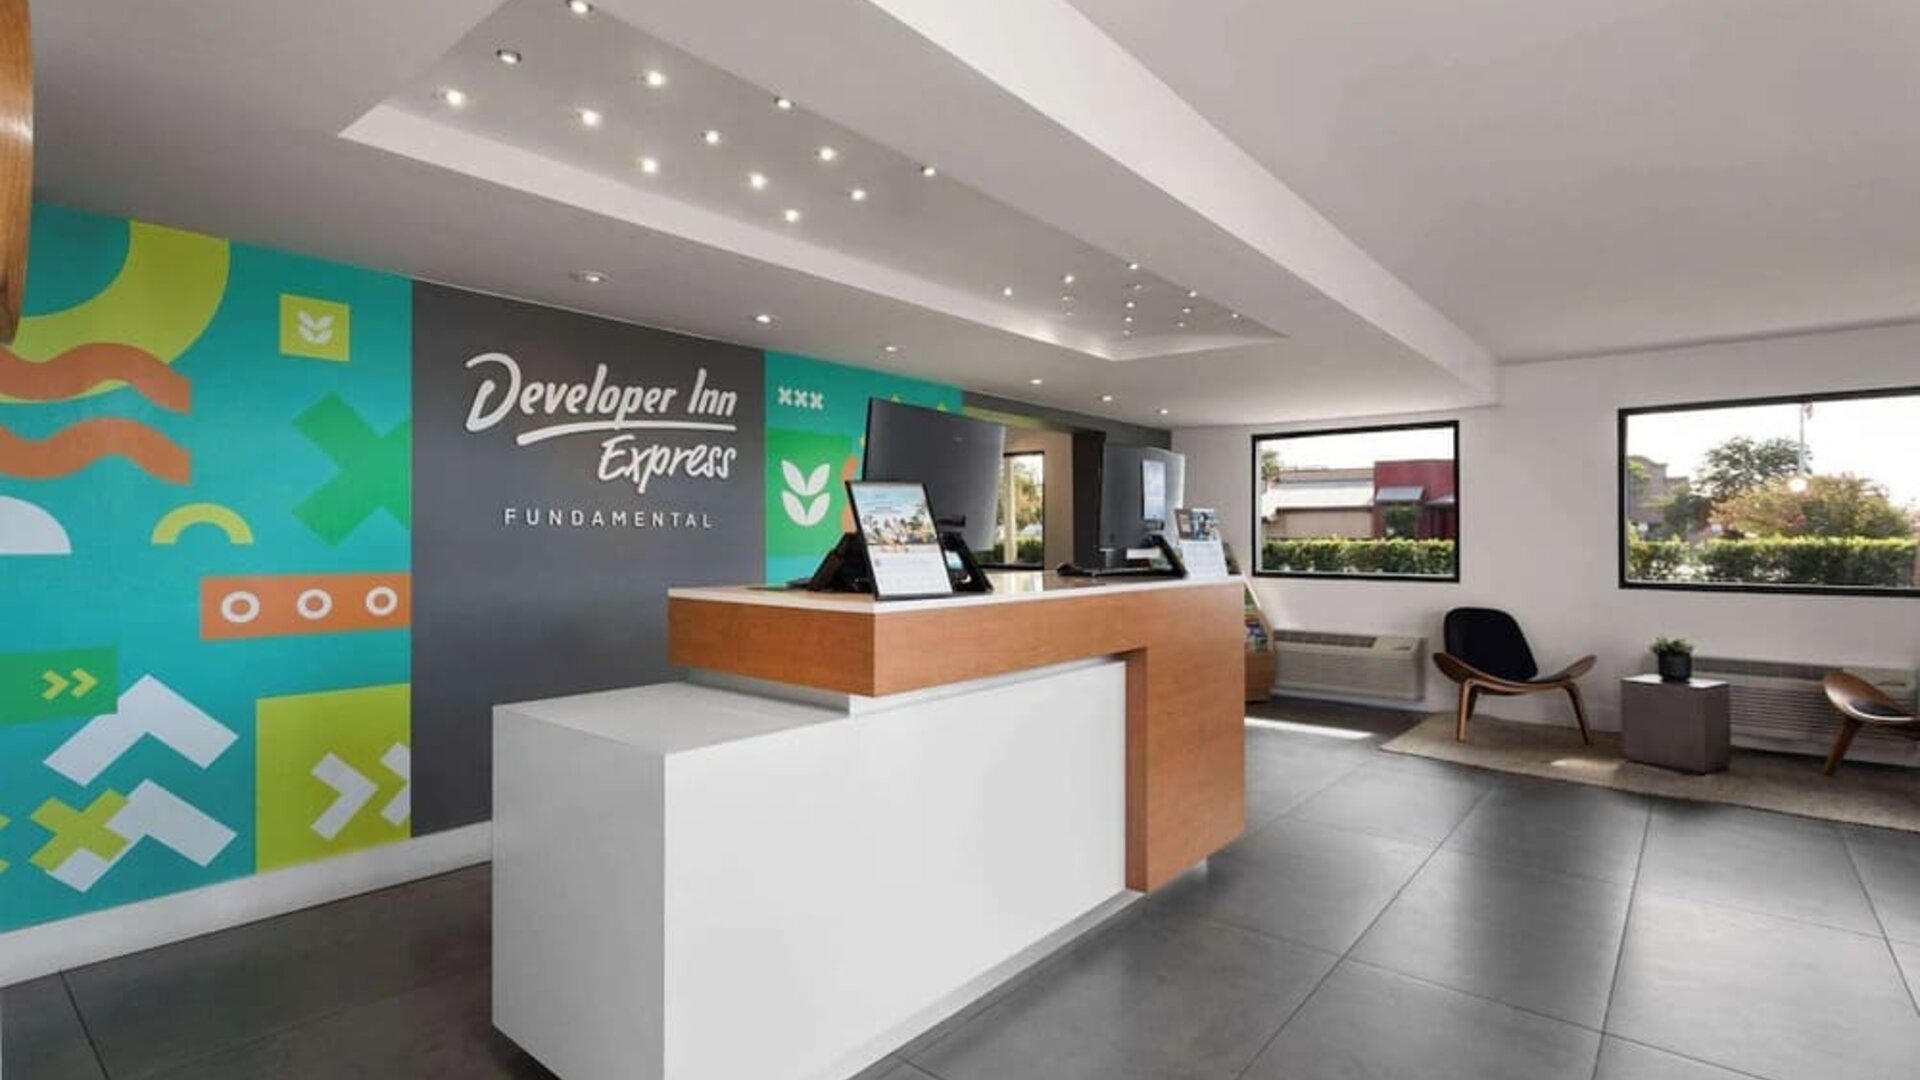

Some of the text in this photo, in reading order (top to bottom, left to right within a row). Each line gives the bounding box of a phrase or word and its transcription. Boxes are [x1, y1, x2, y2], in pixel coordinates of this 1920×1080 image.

[465, 352, 738, 432] Developer Inn
[597, 433, 737, 494] Express
[503, 507, 713, 529] FUNDAMENTAL
